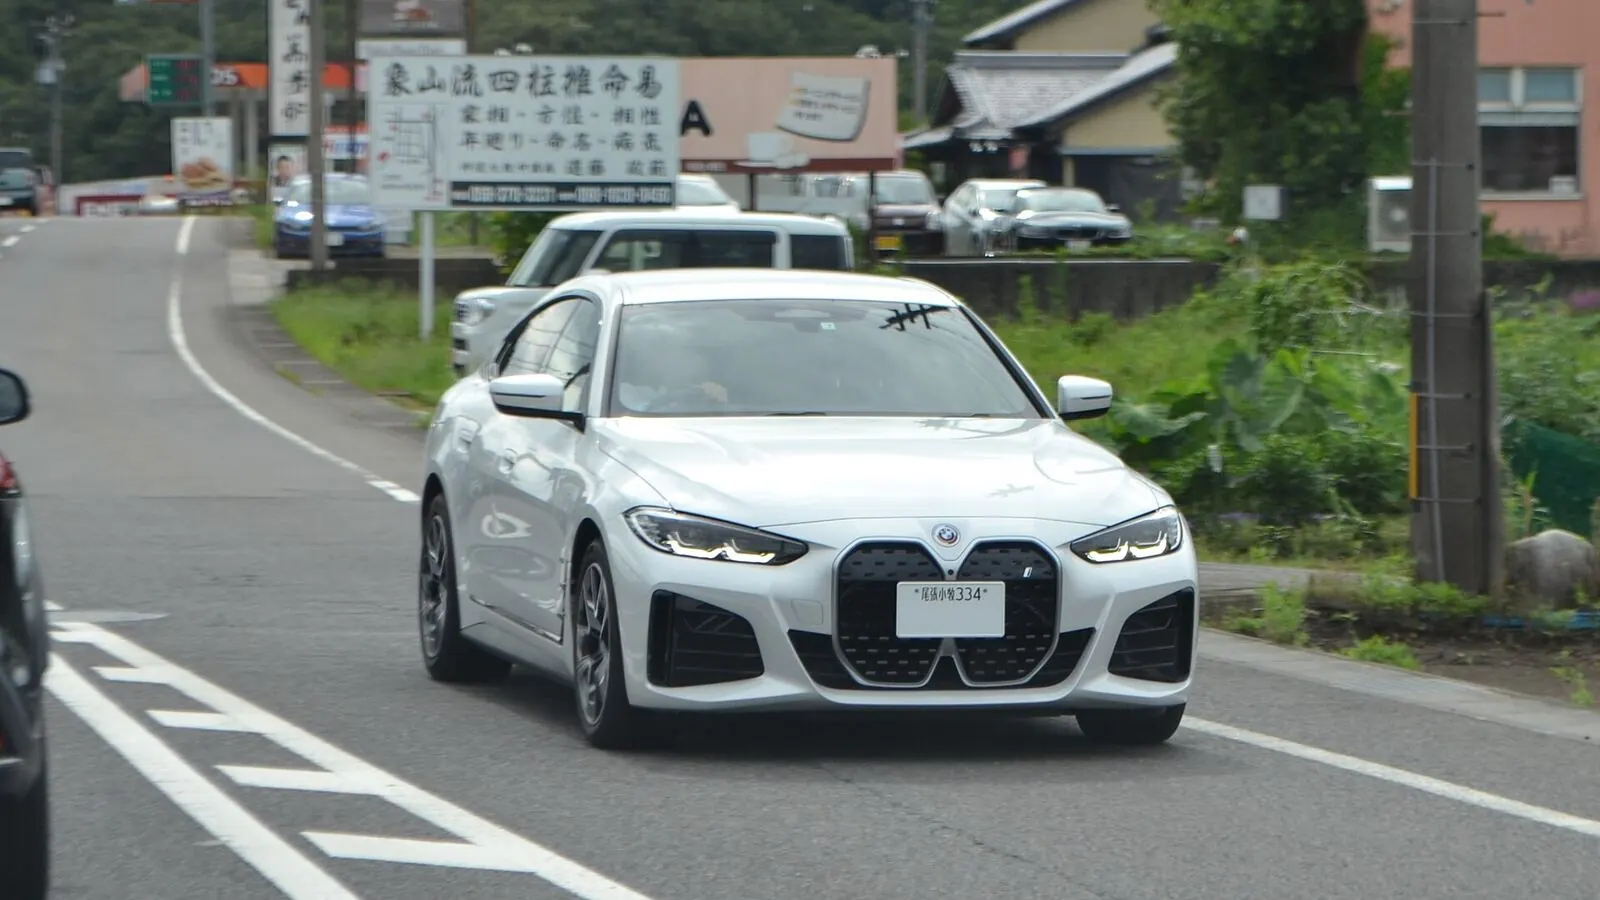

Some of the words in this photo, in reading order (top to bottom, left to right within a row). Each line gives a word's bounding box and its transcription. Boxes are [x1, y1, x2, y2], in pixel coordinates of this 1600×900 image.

[383, 62, 664, 99] 象山流四柱推命易
[921, 586, 982, 602] 尾張小牧334
